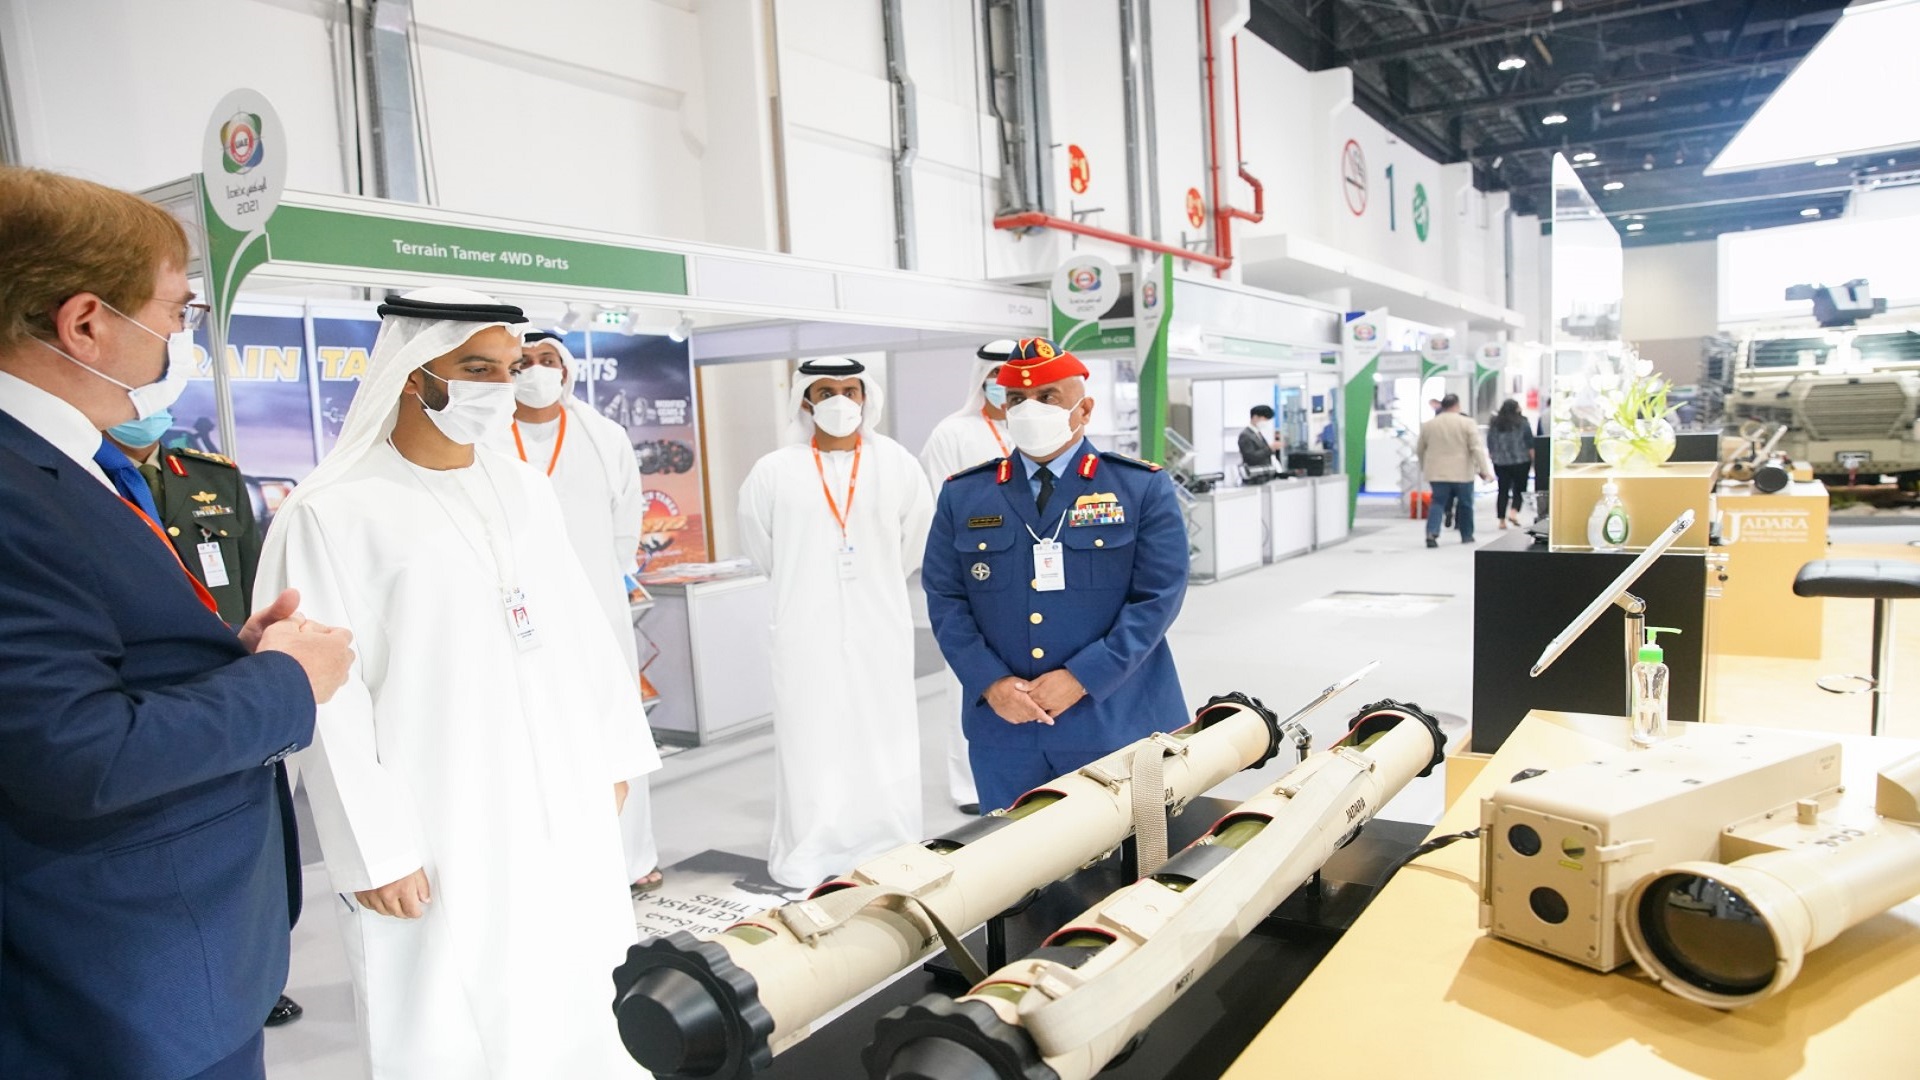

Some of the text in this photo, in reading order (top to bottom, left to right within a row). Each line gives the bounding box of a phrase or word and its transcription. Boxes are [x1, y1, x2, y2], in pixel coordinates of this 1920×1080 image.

[1385, 163, 1396, 231] 1
[237, 200, 260, 215] 2021
[392, 239, 569, 270] Terrain Tamer 4WD Parts
[651, 896, 714, 916] MASK
[690, 894, 751, 912] TIMES
